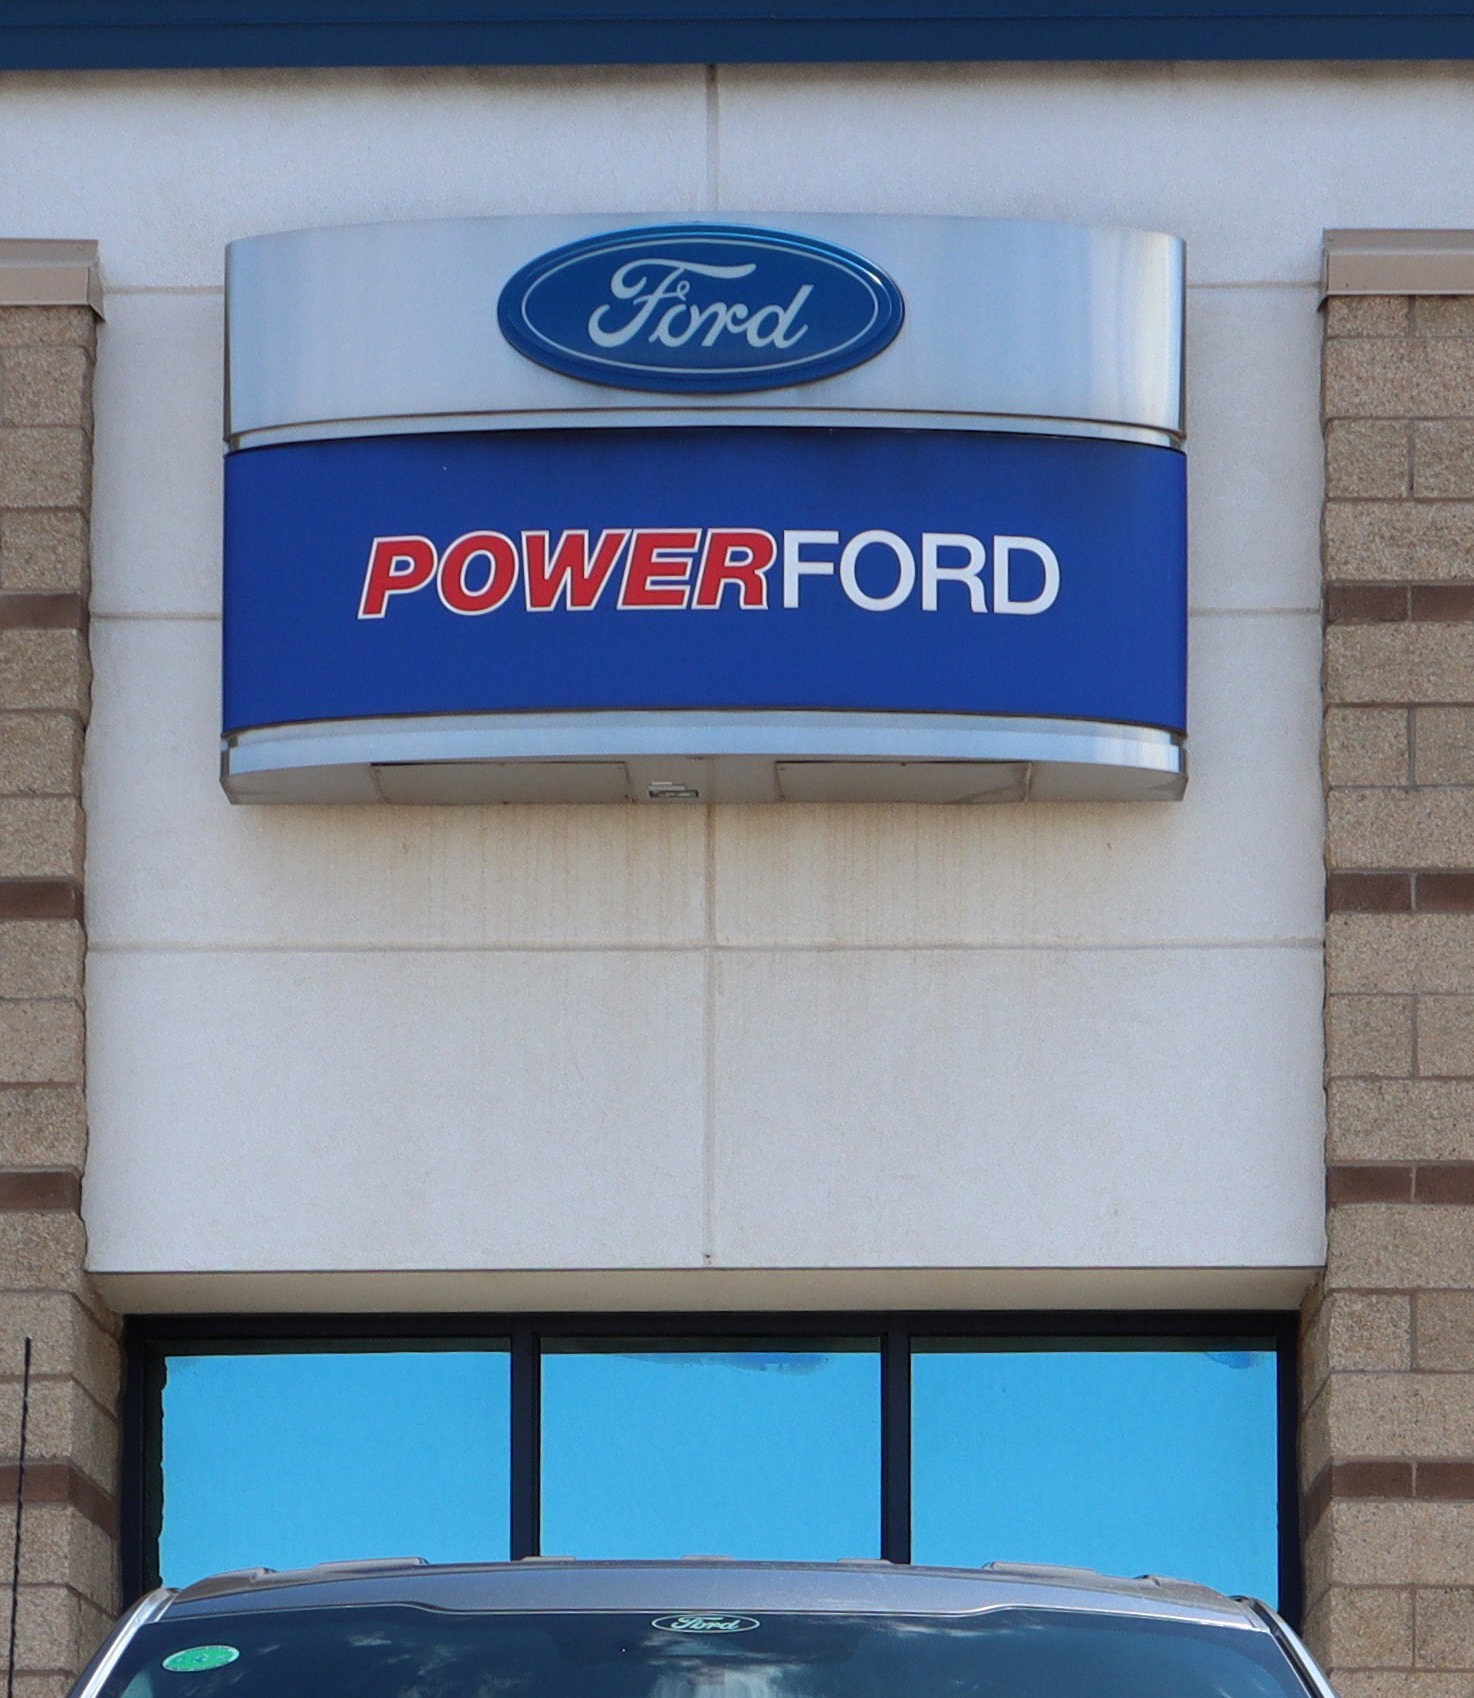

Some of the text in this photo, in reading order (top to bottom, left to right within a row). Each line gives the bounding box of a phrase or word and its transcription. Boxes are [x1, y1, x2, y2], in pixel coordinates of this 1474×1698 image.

[586, 257, 813, 351] Ford
[356, 526, 1061, 620] POWERFORD
[670, 1616, 741, 1631] Ford
